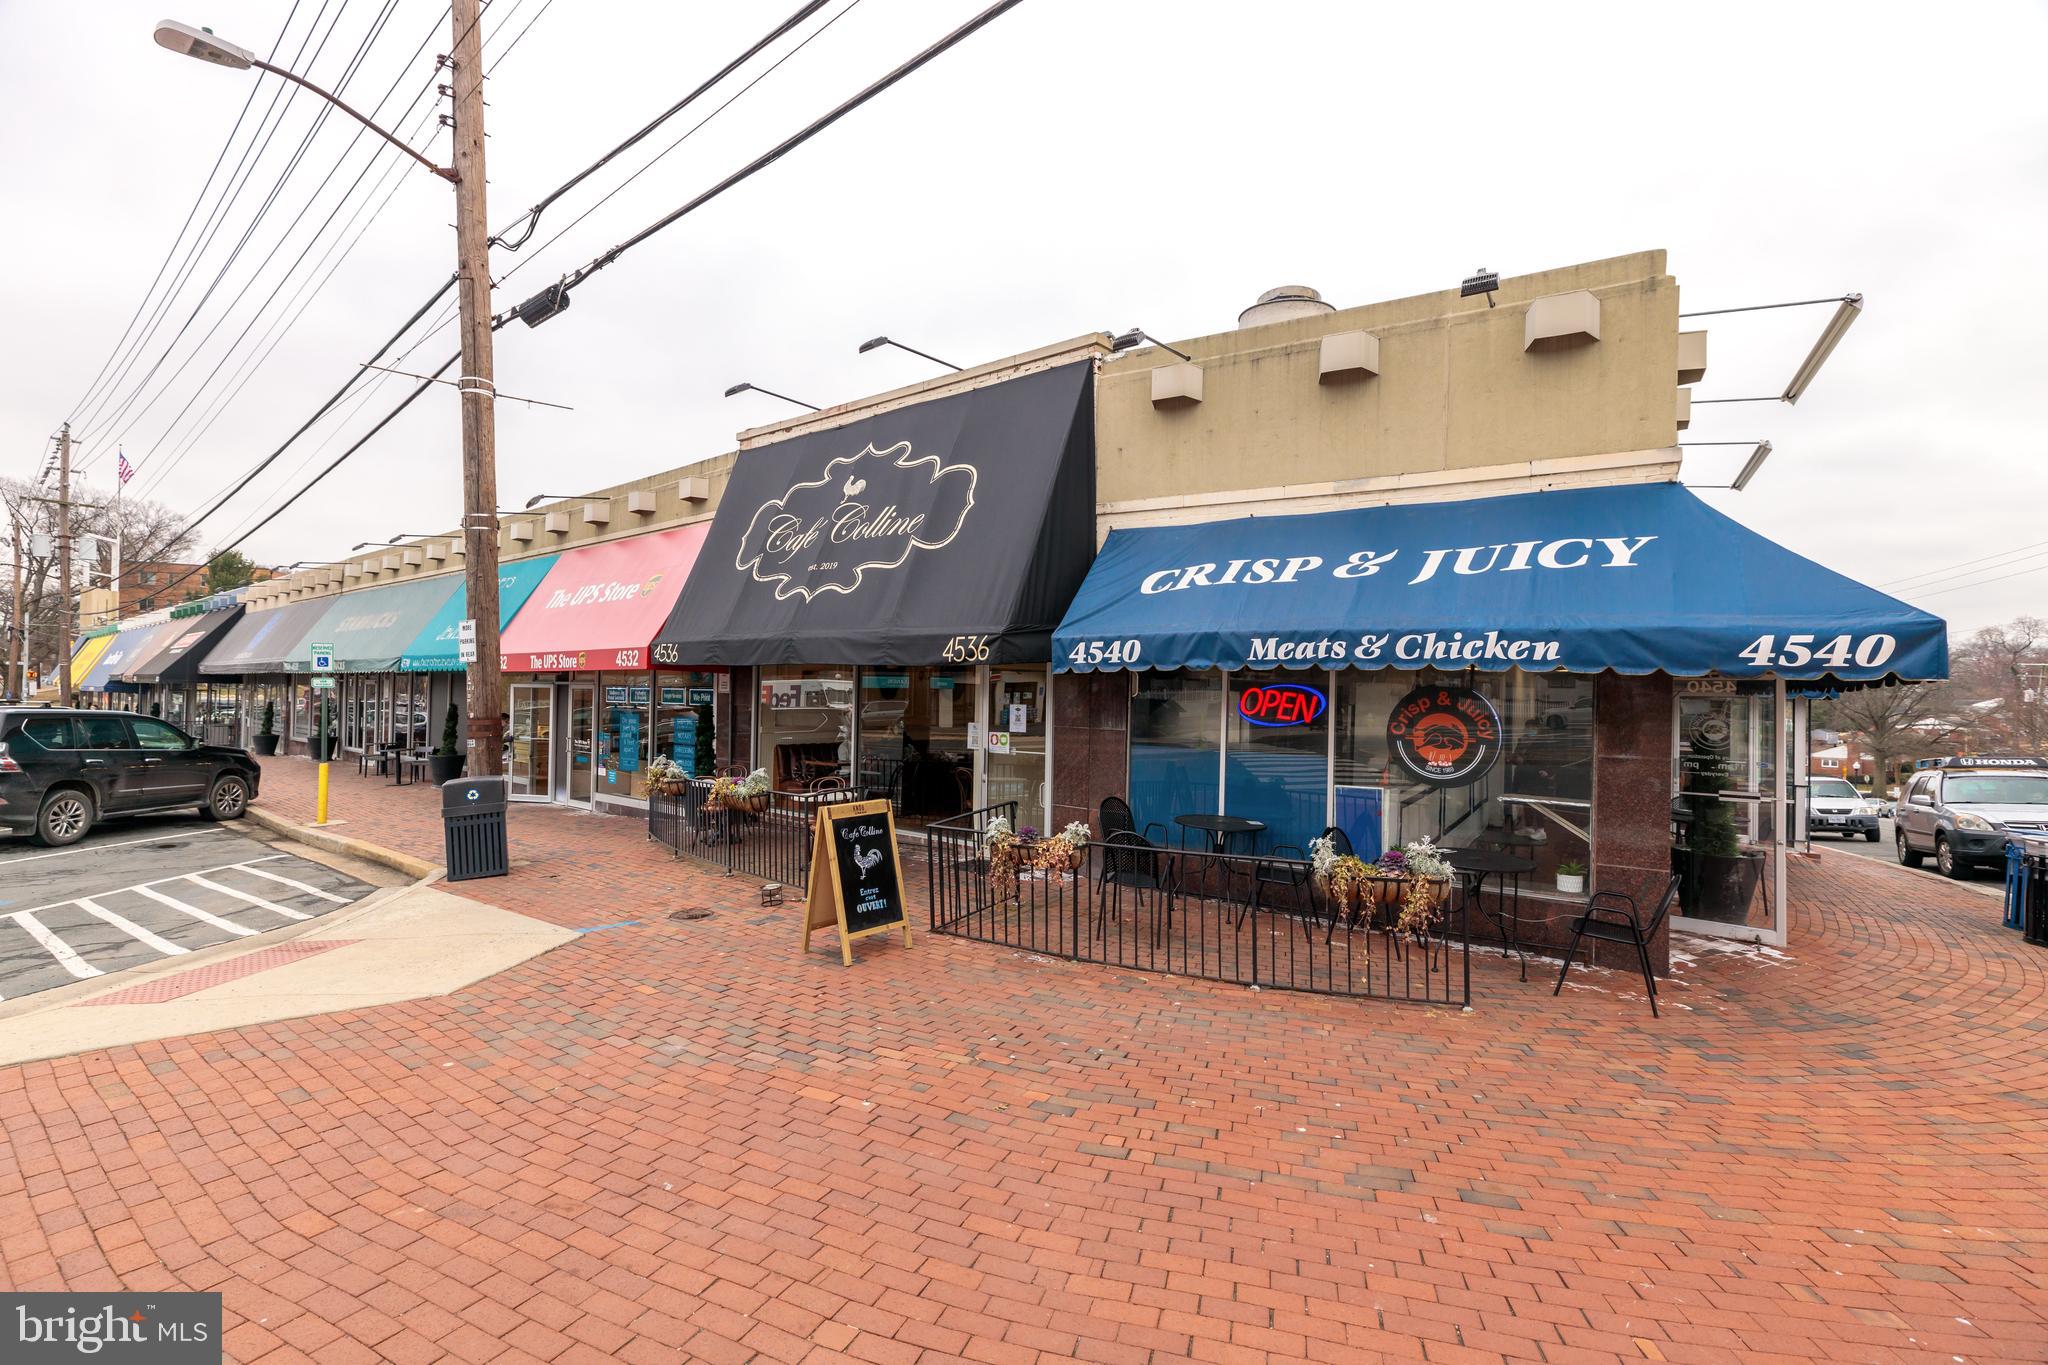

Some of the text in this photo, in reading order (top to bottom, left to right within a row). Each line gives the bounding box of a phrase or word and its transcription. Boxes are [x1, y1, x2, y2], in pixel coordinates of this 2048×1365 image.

[766, 502, 925, 564] Café Colline
[808, 562, 838, 572] est. 2019
[1140, 536, 1659, 595] CRISP & JUICY
[546, 589, 571, 608] The
[570, 584, 603, 605] UPS
[600, 581, 641, 601] Store
[653, 643, 679, 663] 4536
[942, 635, 990, 663] 4536
[1068, 639, 1141, 664] 4540
[1247, 630, 1561, 661] Meats & Chicken
[1738, 633, 1896, 668] 4540
[530, 655, 542, 669] The
[543, 654, 557, 669] UPS
[558, 654, 577, 668] Store
[615, 650, 639, 667] 4532
[693, 693, 711, 701] We Print
[1240, 687, 1318, 723] OPEN
[1390, 691, 1495, 740] Crisp & Juicy
[1975, 758, 2038, 766] HONDA
[858, 825, 883, 837] Colline
[860, 887, 880, 896] Entrez
[856, 898, 887, 913] OUVERT!
